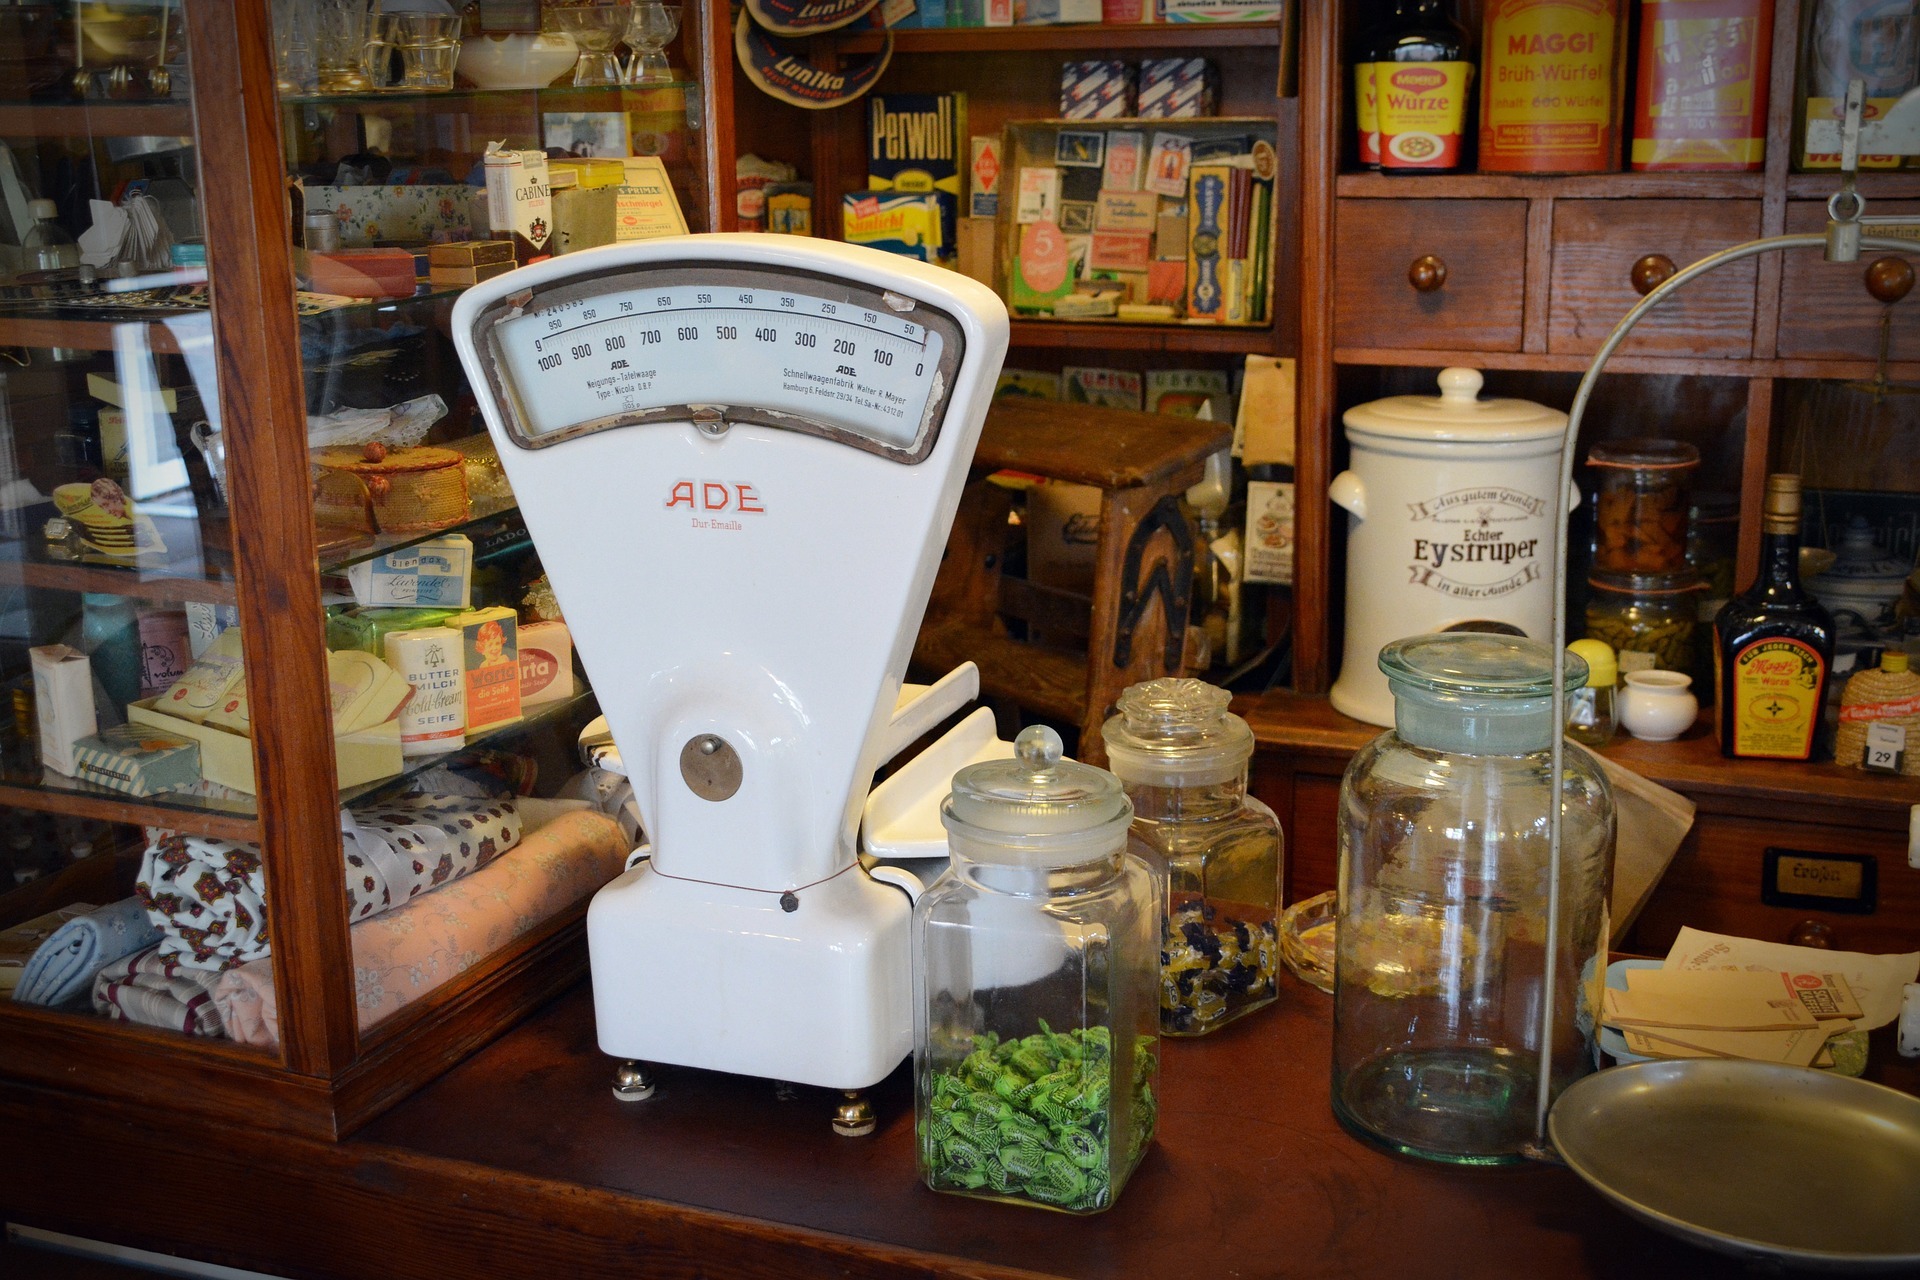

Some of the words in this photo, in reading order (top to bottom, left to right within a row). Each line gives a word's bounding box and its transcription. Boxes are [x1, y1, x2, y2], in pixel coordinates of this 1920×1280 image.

[1508, 32, 1595, 55] MAGGI
[775, 56, 845, 90] Lunika
[1499, 63, 1603, 83] Brüh-Würfel
[872, 95, 953, 161] Perwoll
[516, 184, 551, 202] CABINE
[618, 186, 661, 195] S-PRIMA
[1035, 229, 1054, 256] 5
[549, 318, 562, 331] 950
[582, 309, 597, 320] 850
[619, 301, 633, 312] 750
[657, 296, 672, 307] 650
[697, 294, 712, 304] 550
[738, 294, 753, 305] 450
[780, 297, 795, 308] 350
[821, 303, 837, 315] 250
[863, 312, 878, 324] 150
[904, 324, 915, 335] 50
[535, 339, 543, 352] g
[538, 353, 562, 372] 1000
[571, 343, 592, 360] 900
[605, 335, 626, 352] 800
[640, 330, 661, 346] 700
[677, 326, 699, 341] 600
[716, 326, 737, 341] 500
[755, 328, 777, 342] 400
[795, 332, 816, 348] 300
[833, 338, 856, 356] 200
[873, 348, 893, 366] 100
[915, 363, 924, 377] 0
[611, 359, 630, 371] ADE
[835, 364, 857, 377] ADE
[614, 384, 635, 396] Nicola
[783, 367, 855, 390] Schnellwaagenfabrik
[856, 383, 877, 396] Walter
[884, 391, 907, 406] Mayer
[783, 382, 809, 395] Hamburg
[666, 481, 765, 513] ADE
[1463, 529, 1503, 541] Echter
[1414, 538, 1538, 569] Eystruper
[1437, 578, 1450, 592] in
[1453, 583, 1480, 597] aller
[408, 668, 460, 682] BUTTER
[519, 661, 549, 679] rta
[415, 680, 457, 692] MILCH
[417, 713, 457, 726] SEIFE
[1874, 751, 1892, 764] 29
